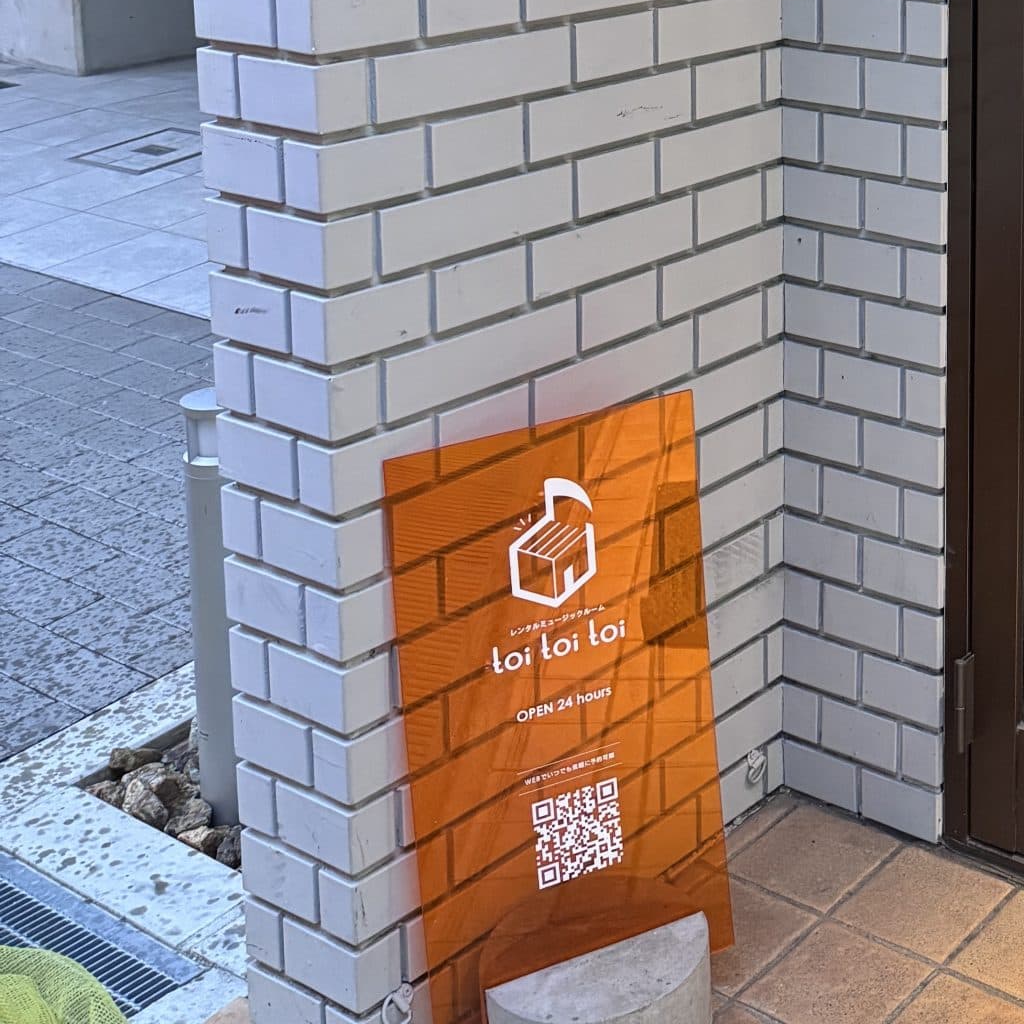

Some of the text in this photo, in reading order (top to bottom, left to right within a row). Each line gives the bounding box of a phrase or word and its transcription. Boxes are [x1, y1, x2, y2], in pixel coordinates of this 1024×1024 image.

[510, 604, 606, 637] レンタルミュージックルーム
[492, 619, 626, 674] toi toi toi
[516, 686, 612, 723] OPEN 24 hours
